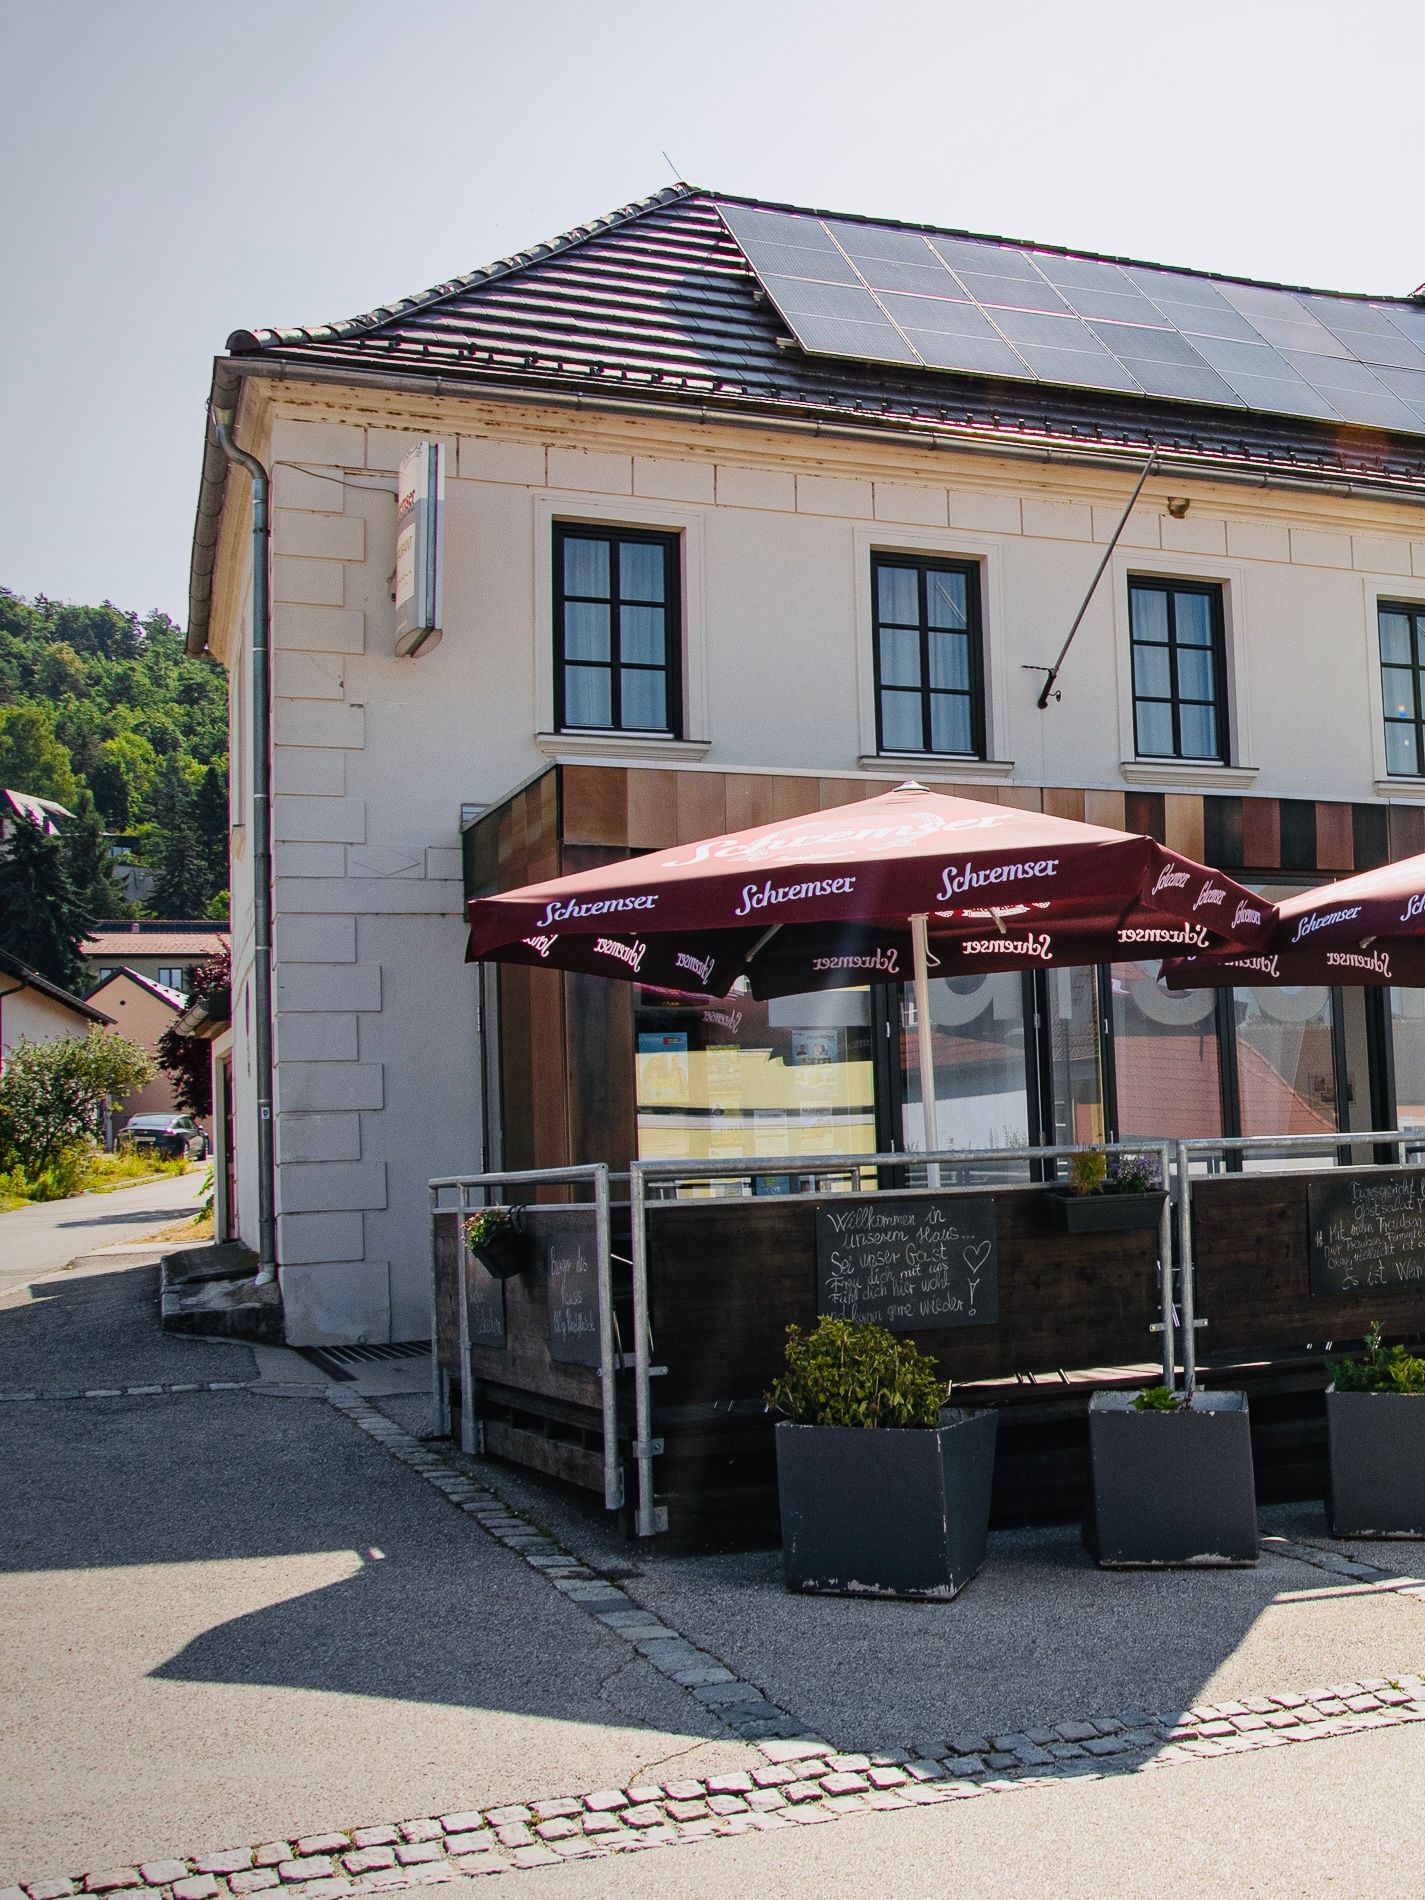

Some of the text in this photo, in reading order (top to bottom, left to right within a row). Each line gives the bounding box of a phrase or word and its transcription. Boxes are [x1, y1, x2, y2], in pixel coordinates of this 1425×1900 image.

[735, 872, 856, 916] Schremser
[936, 856, 1059, 901] Schremser
[1151, 862, 1190, 896] Schremser
[536, 894, 659, 928] Schremser
[1192, 880, 1227, 911] Schremser
[1231, 900, 1261, 929] Schremser
[1292, 904, 1361, 944] Schremser
[827, 1205, 946, 1232] Willkommen in
[842, 1231, 908, 1249] unserem
[831, 1242, 949, 1277] Sei unser Gast
[825, 1262, 949, 1293] Freu dich mit uns
[827, 1271, 951, 1304] Fühl dich hier wohl
[919, 1292, 964, 1314] wieder
